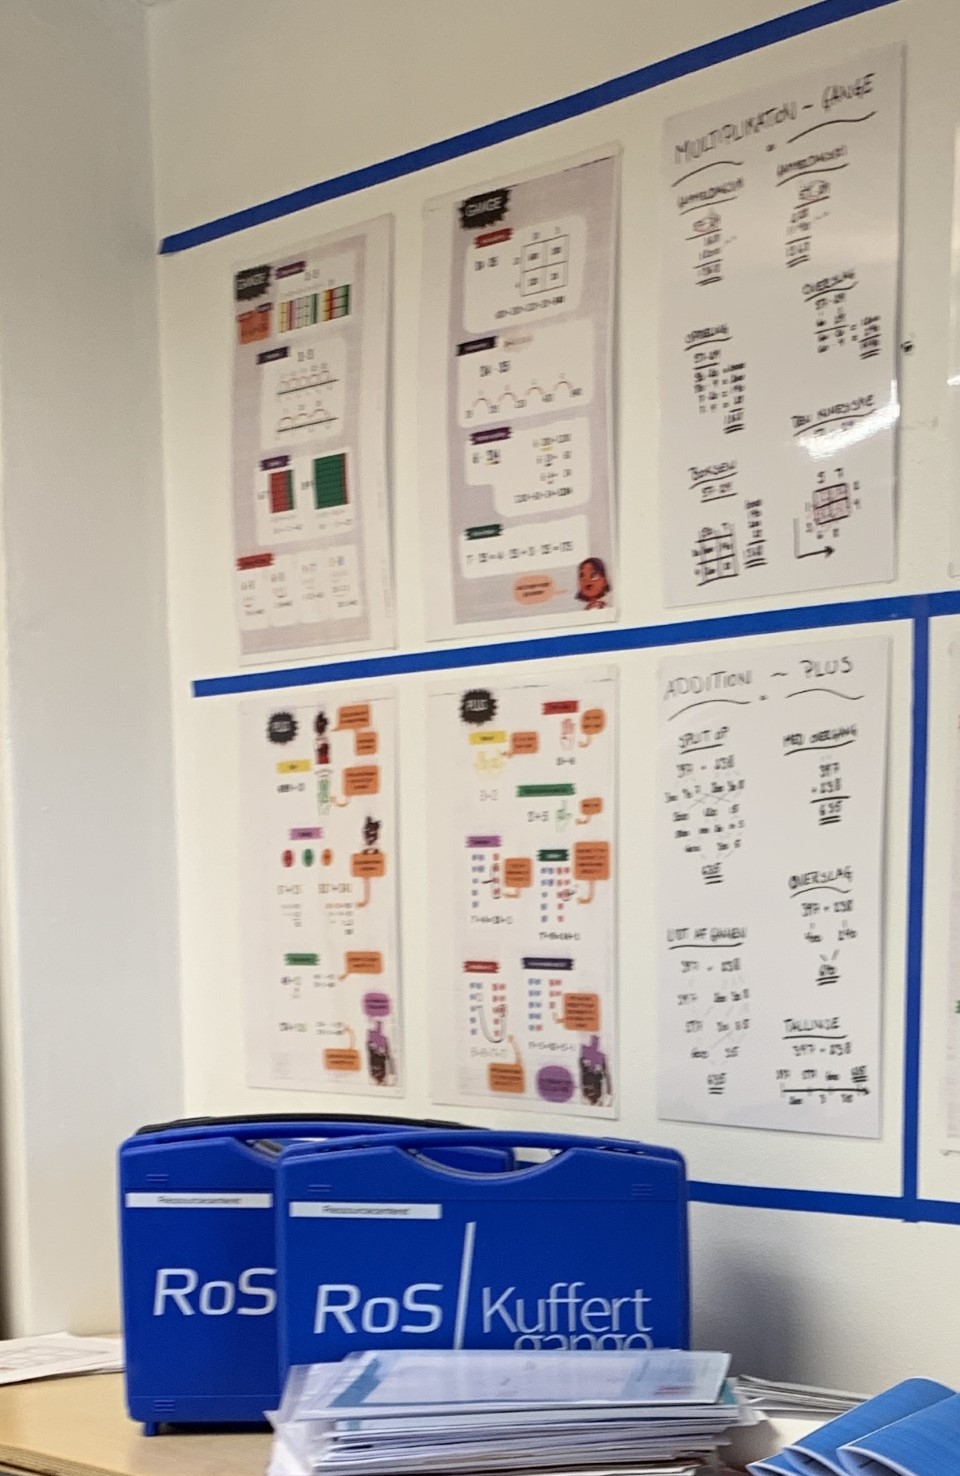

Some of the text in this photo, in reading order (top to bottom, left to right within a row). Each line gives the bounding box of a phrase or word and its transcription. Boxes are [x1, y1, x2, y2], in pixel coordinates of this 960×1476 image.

[664, 656, 854, 701] ADDITION PLUS
[788, 865, 854, 890] OVERSLAG
[153, 1268, 278, 1317] RoS
[313, 1282, 654, 1335] RoS Kuffert
